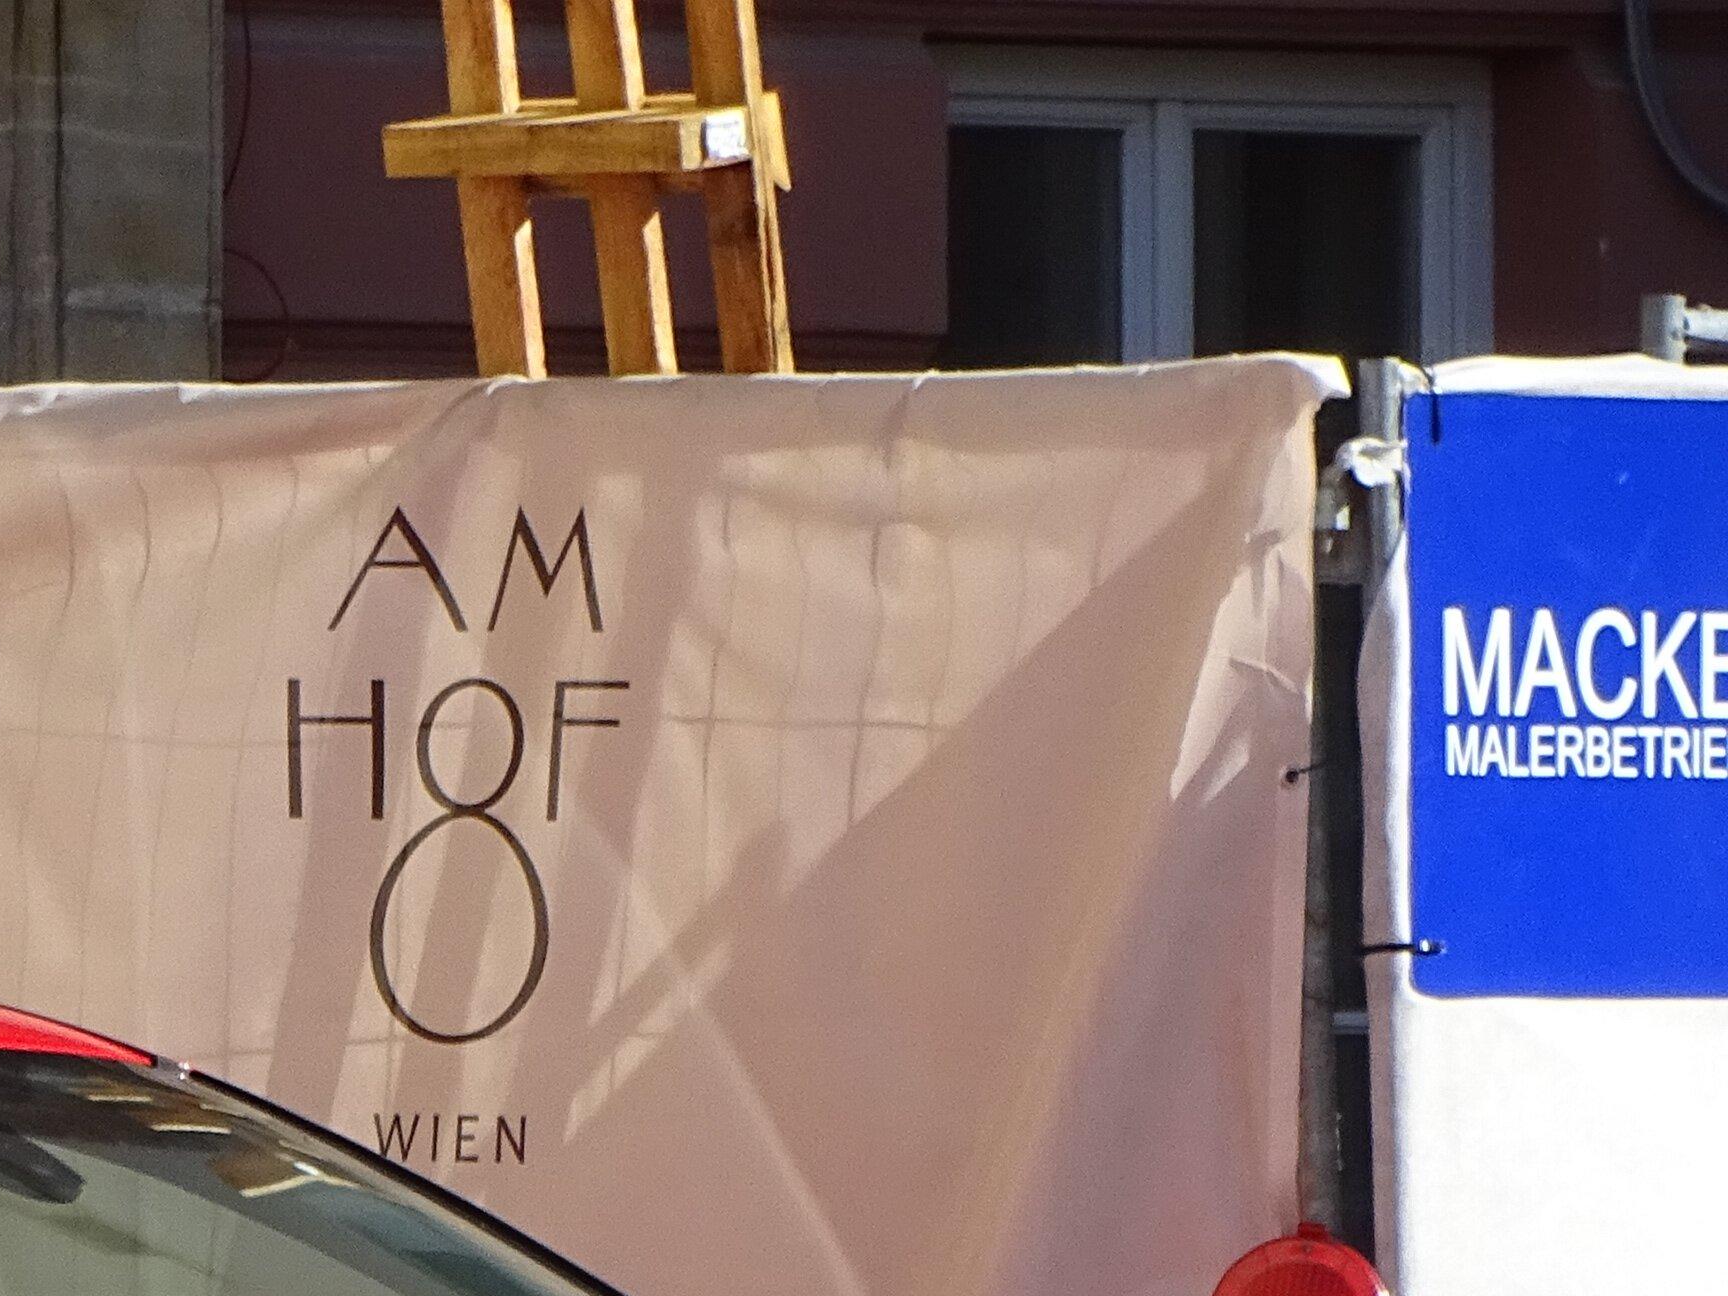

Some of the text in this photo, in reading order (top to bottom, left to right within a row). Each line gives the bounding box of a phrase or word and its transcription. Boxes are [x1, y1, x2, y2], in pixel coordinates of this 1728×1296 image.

[328, 506, 604, 633] AM
[286, 677, 631, 822] HOF
[372, 1112, 528, 1165] WIEN
